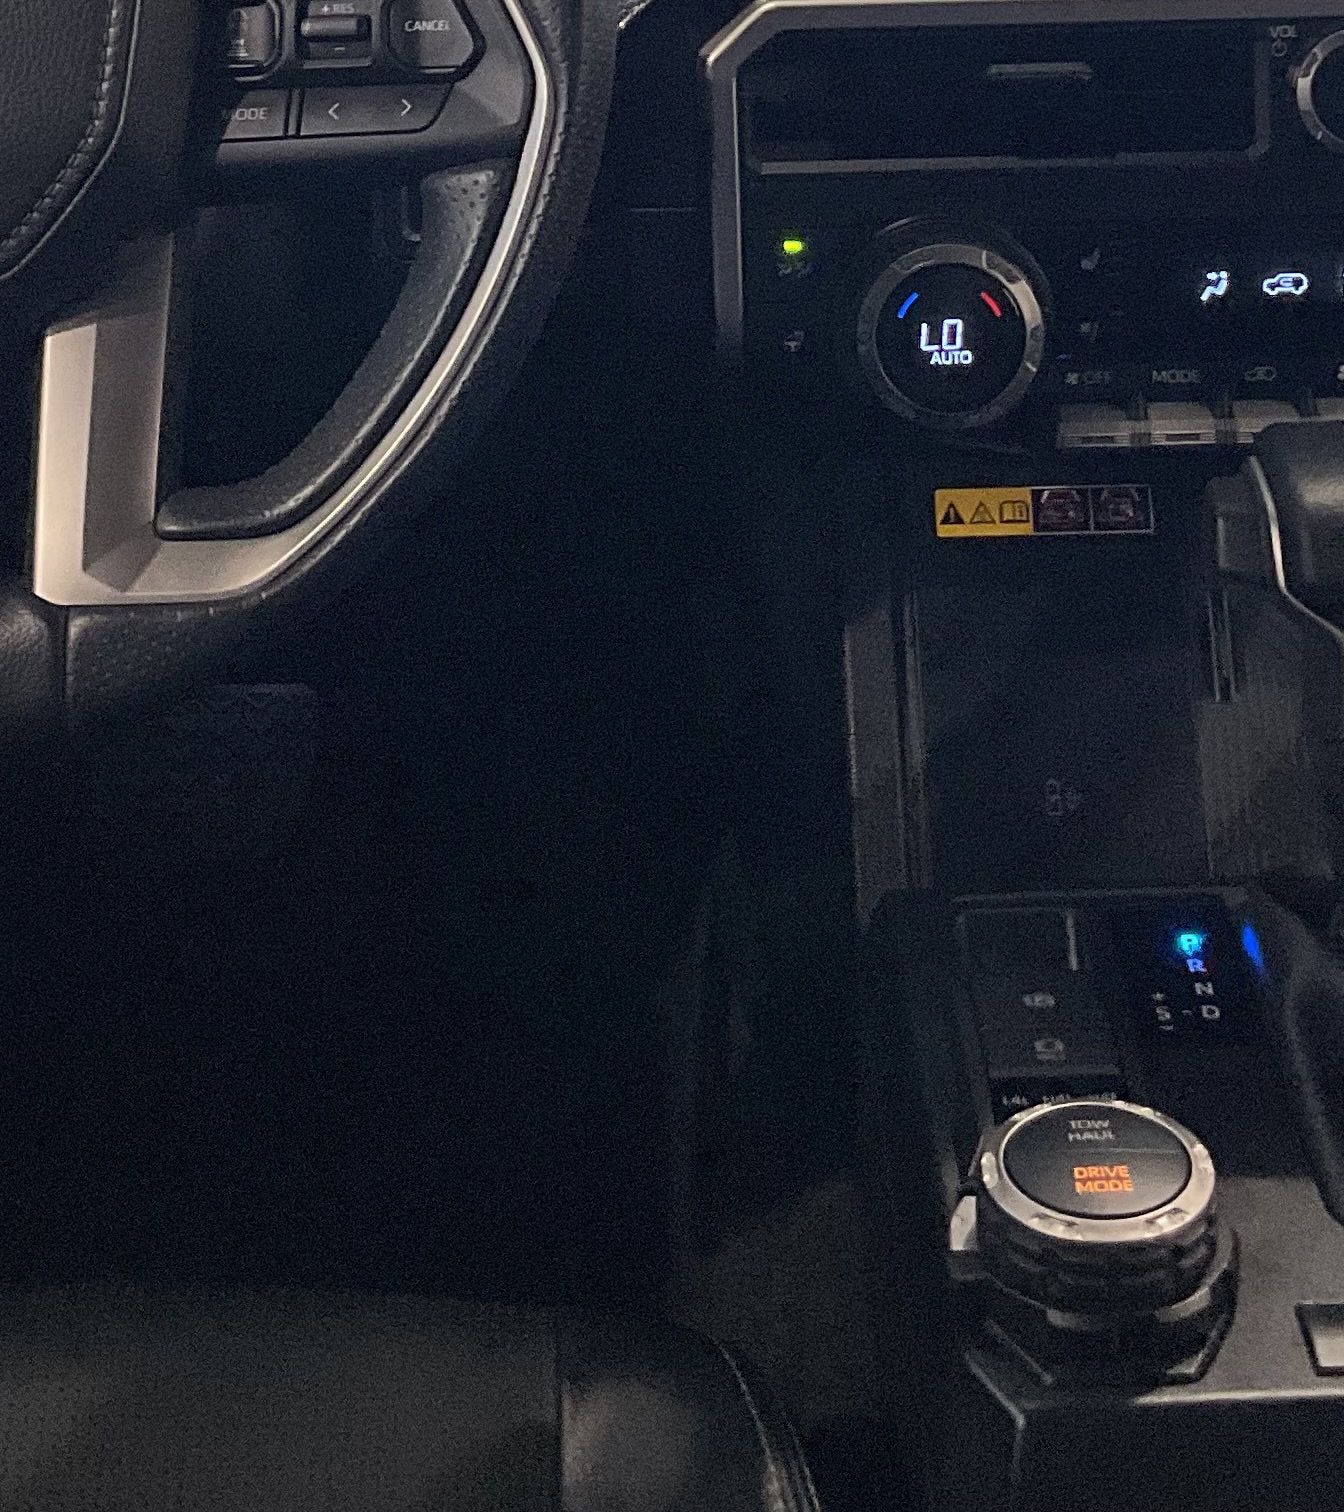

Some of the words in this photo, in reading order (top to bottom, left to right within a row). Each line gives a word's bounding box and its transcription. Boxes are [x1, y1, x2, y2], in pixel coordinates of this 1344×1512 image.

[404, 19, 451, 32] CANCEL
[1268, 25, 1298, 39] VOL
[929, 350, 974, 365] AUTO
[1152, 369, 1202, 384] MODE
[1194, 982, 1215, 996] N
[1201, 1004, 1221, 1020] D
[1073, 1163, 1130, 1180] DRIVE
[1074, 1178, 1134, 1194] MODE
